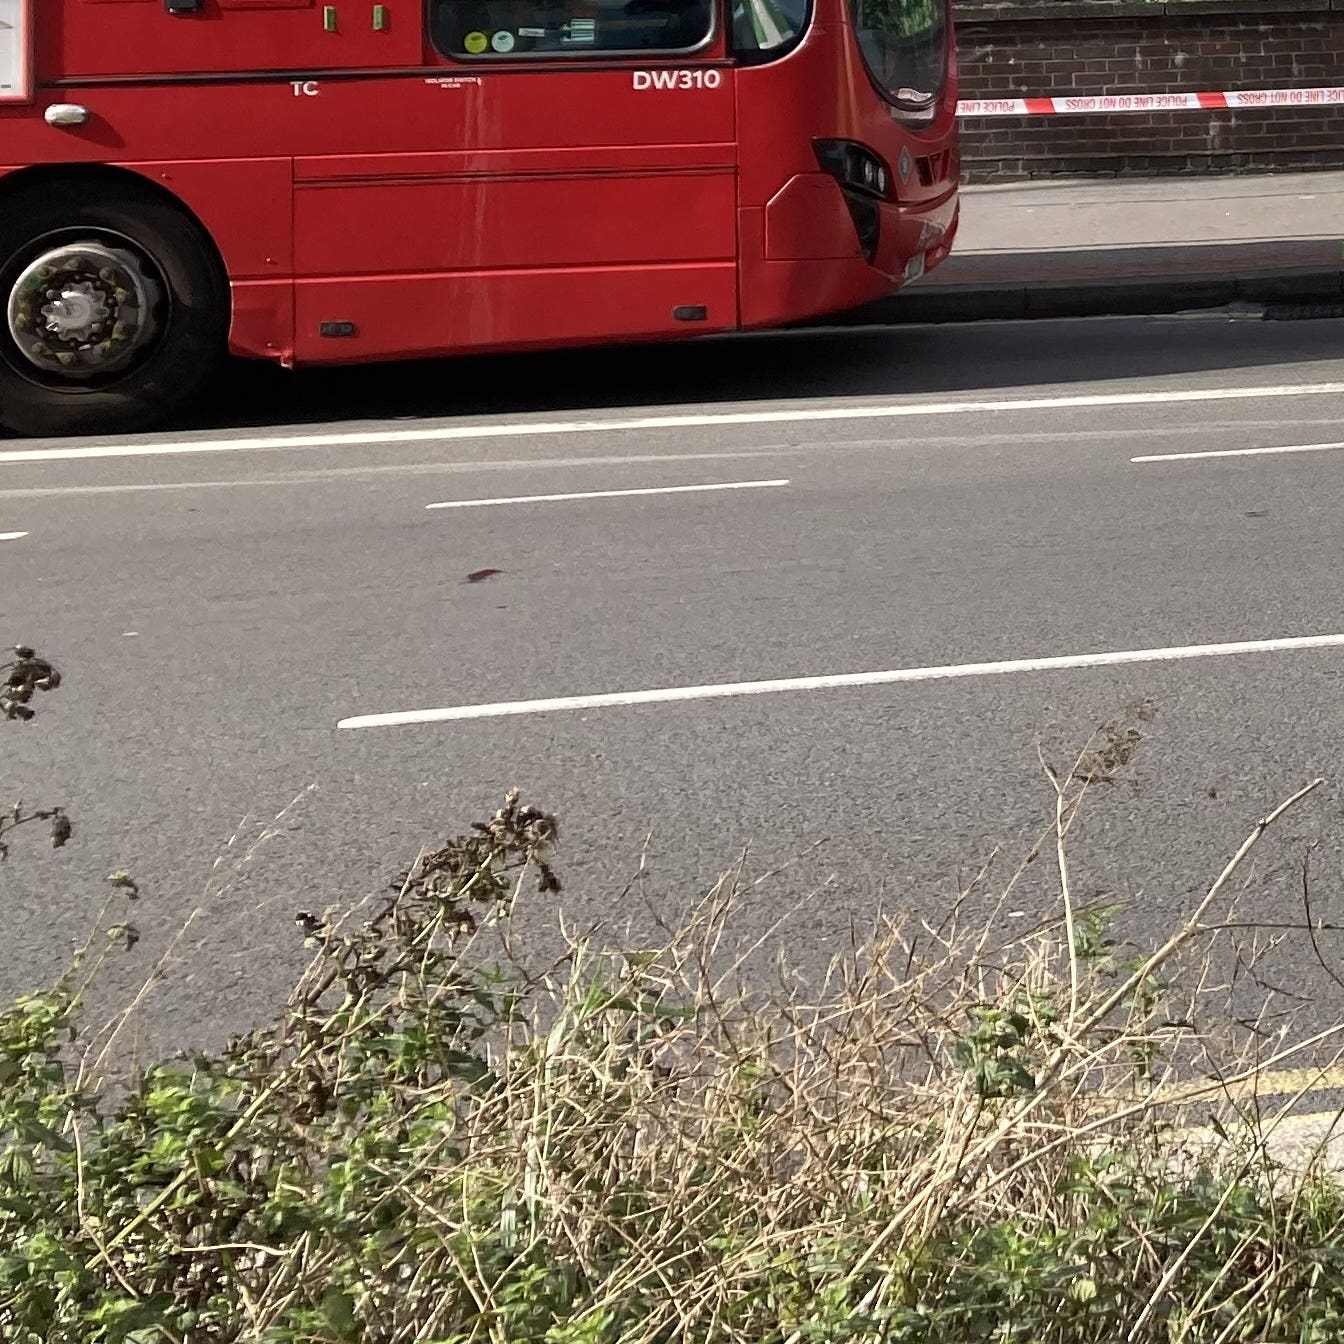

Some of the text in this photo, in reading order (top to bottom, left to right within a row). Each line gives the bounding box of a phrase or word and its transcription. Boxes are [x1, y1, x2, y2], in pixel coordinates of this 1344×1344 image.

[633, 69, 720, 90] DW310
[290, 80, 319, 96] TC
[1237, 92, 1267, 105] CROSS
[1270, 92, 1287, 104] NOT
[1290, 91, 1302, 103] DO
[1305, 90, 1324, 102] LINE
[960, 100, 1015, 113] POLICE LINE
[1065, 95, 1188, 111] POLICE LINE DO NOT CROSS
